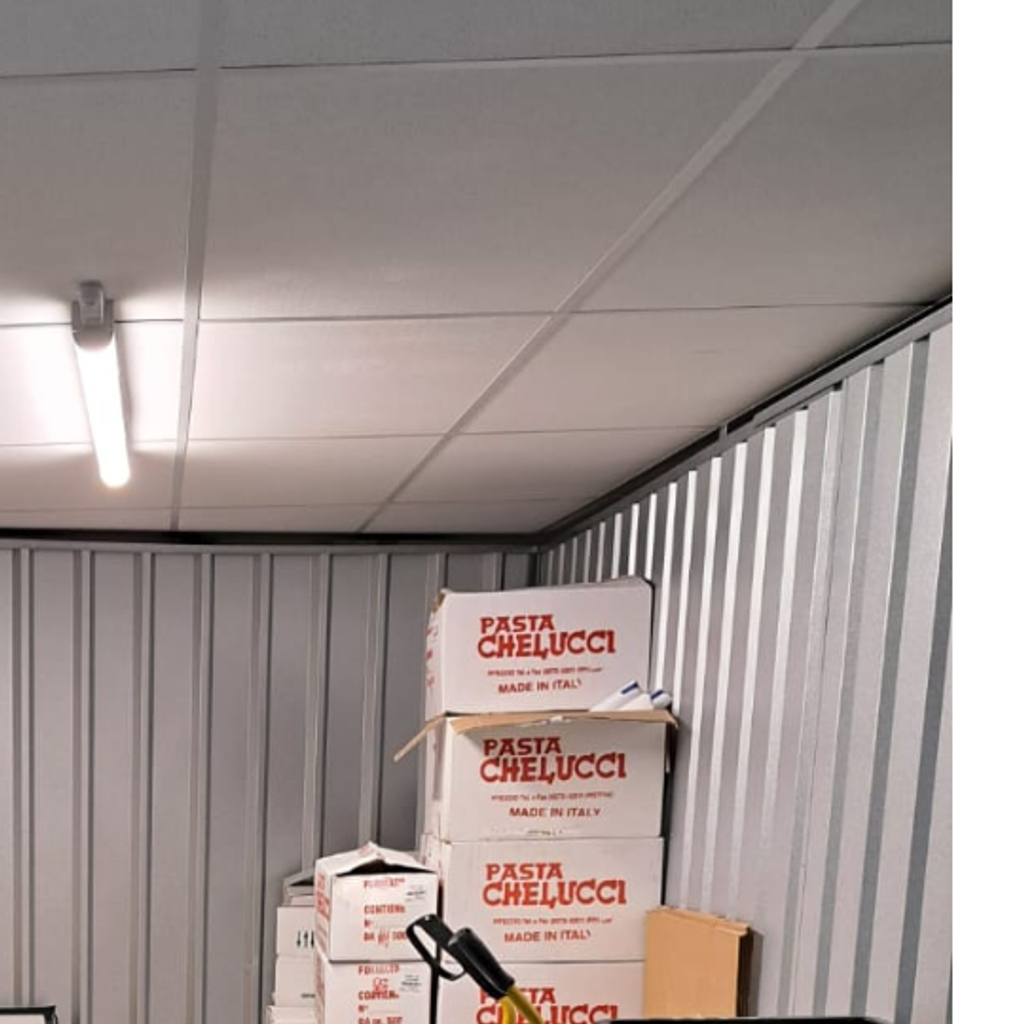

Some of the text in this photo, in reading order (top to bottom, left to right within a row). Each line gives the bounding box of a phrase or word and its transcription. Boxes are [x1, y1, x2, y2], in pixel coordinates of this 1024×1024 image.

[479, 614, 555, 635] PASTA
[477, 629, 616, 660] CHELUCCI
[498, 683, 533, 694] MADE
[537, 682, 550, 692] IN
[482, 736, 563, 756] PASTA
[480, 752, 628, 785] CHELUCCI
[509, 807, 601, 817] MADE IN ITALY
[485, 862, 563, 881] PASTA
[482, 878, 628, 909] CHELUCCI
[504, 931, 541, 942] MADE
[544, 931, 557, 942] IN
[479, 986, 556, 1004] PTA
